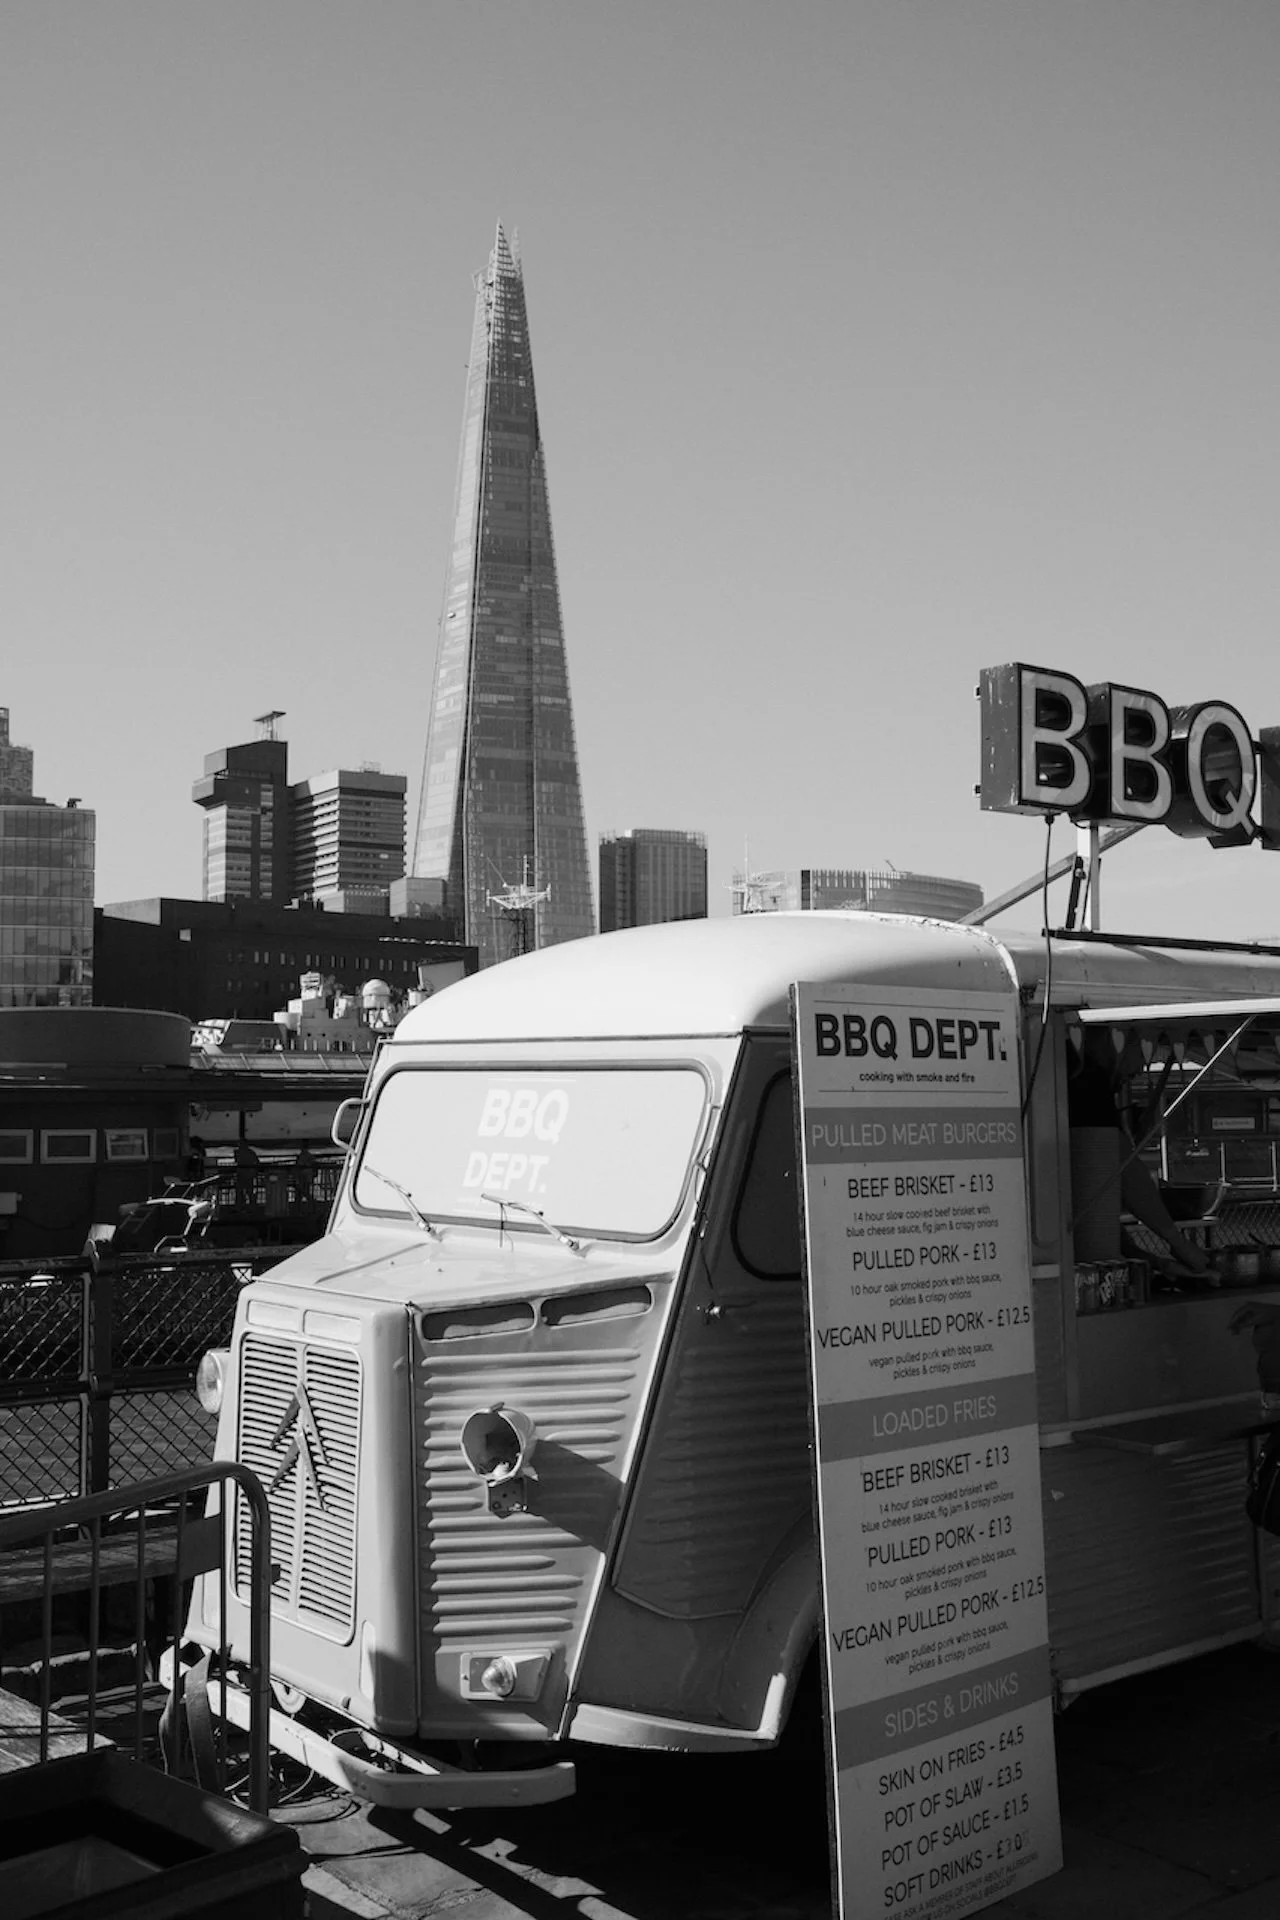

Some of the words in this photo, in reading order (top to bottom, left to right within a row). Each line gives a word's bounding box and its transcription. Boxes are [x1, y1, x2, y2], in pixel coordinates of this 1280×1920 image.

[1018, 662, 1257, 842] BBQ
[815, 1013, 898, 1060] BBQ
[909, 1017, 1007, 1061] DEPT.
[859, 1071, 894, 1083] cooking
[896, 1071, 914, 1081] with
[916, 1072, 942, 1082] smoke
[945, 1072, 960, 1082] and
[961, 1073, 975, 1083] fire
[478, 1089, 569, 1145] BBQ
[812, 1123, 886, 1148] PULLED
[892, 1123, 937, 1145] MEAT
[943, 1122, 1017, 1144] BURGERS
[462, 1151, 550, 1193] DEPT.
[848, 1177, 889, 1199] BEEF
[894, 1174, 956, 1197] BRISKET
[969, 1173, 994, 1193] £13
[846, 1226, 865, 1238] blue
[867, 1224, 895, 1236] cheese
[955, 1219, 976, 1231] crispy
[977, 1218, 999, 1229] onions
[853, 1212, 863, 1222] 14
[865, 1211, 884, 1221] hour
[886, 1210, 903, 1220] slow
[934, 1207, 951, 1217] beef
[853, 1248, 914, 1271] PULLED
[920, 1244, 961, 1265] PORK
[973, 1241, 997, 1261] £13
[850, 1285, 860, 1296] 10
[862, 1284, 882, 1295] hour
[884, 1282, 898, 1292] oak
[900, 1279, 930, 1291] smoked
[932, 1278, 948, 1289] pork
[950, 1275, 964, 1286] with
[965, 1274, 980, 1286] bbq
[889, 1295, 916, 1308] pickles
[925, 1291, 947, 1304] crispy
[949, 1289, 972, 1300] onions
[817, 1324, 877, 1349] VEGAN
[882, 1316, 941, 1341] PULLED
[945, 1311, 985, 1333] PORK
[997, 1306, 1030, 1327] £12.5
[868, 1356, 893, 1369] vegan
[895, 1352, 920, 1365] pulled
[922, 1350, 940, 1362] pork
[941, 1347, 956, 1358] with
[893, 1366, 920, 1380] pickles
[929, 1362, 951, 1375] crispy
[953, 1359, 976, 1371] onions
[872, 1404, 948, 1437] LOADED
[953, 1395, 997, 1423] FRIES
[863, 1465, 905, 1493] BEEF
[910, 1452, 971, 1484] BRISKET
[985, 1445, 1010, 1468] £13
[861, 1521, 880, 1533] blue
[881, 1516, 911, 1529] cheese
[970, 1497, 991, 1510] crispy
[992, 1491, 1015, 1504] onions
[879, 1503, 889, 1514] 14
[890, 1500, 910, 1512] hour
[911, 1496, 929, 1508] slow
[930, 1491, 958, 1504] cooked
[868, 1535, 931, 1568] PULLED
[935, 1523, 976, 1552] PORK
[988, 1515, 1012, 1538] £13
[866, 1581, 877, 1592] 10
[878, 1578, 898, 1590] hour
[900, 1574, 914, 1585] oak
[916, 1566, 946, 1581] smoked
[947, 1560, 964, 1573] pork
[965, 1555, 981, 1568] with
[905, 1586, 932, 1601] pickles
[940, 1576, 963, 1590] crispy
[964, 1569, 987, 1583] onions
[832, 1618, 892, 1652] VEGAN
[897, 1602, 957, 1637] PULLED
[961, 1588, 1000, 1619] PORK
[1012, 1575, 1045, 1602] £12.5
[884, 1650, 910, 1665] vegan
[911, 1642, 936, 1658] pulled
[937, 1638, 954, 1653] pork
[908, 1660, 936, 1676] pickles
[944, 1649, 966, 1664] crispy
[967, 1641, 991, 1656] onions
[884, 1700, 939, 1737] SIDES
[943, 1694, 955, 1719] &
[960, 1672, 1019, 1713] DRINKS
[879, 1765, 915, 1796] SKIN
[920, 1755, 944, 1781] ON
[948, 1740, 985, 1771] FRIES
[999, 1725, 1024, 1752] £4.5
[884, 1802, 915, 1832] POT
[920, 1793, 940, 1818] OF
[945, 1776, 983, 1808] SLAW
[997, 1761, 1023, 1788] £3.5
[882, 1840, 912, 1871] POT
[917, 1830, 938, 1855] OF
[942, 1809, 990, 1846] SAUCE
[1004, 1793, 1029, 1820] £1.5
[884, 1873, 924, 1908] SOFT
[930, 1849, 983, 1889] DRINKS
